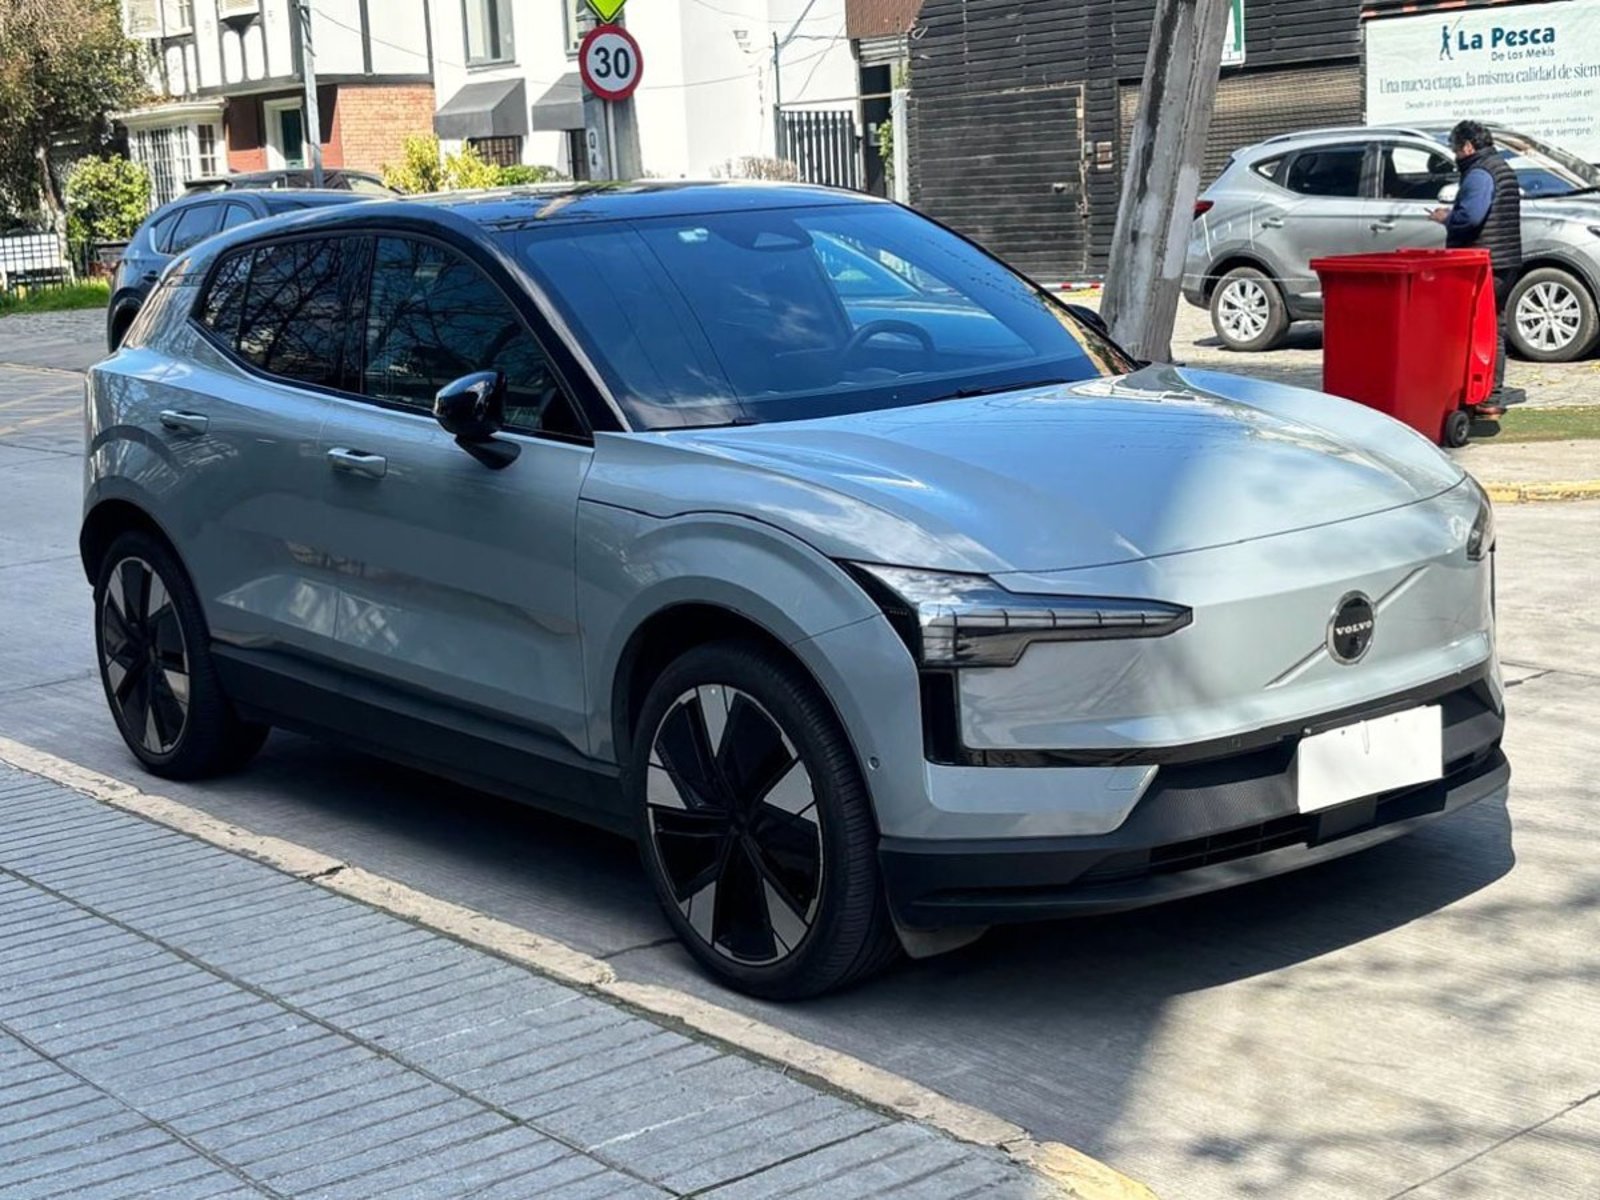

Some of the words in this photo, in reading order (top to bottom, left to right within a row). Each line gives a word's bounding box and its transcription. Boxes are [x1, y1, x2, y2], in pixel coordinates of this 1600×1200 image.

[1458, 31, 1483, 51] La
[1491, 27, 1555, 49] Pesca
[594, 47, 631, 79] 30
[1491, 51, 1504, 61] De
[1507, 49, 1523, 60] Los
[1525, 46, 1555, 58] Mekis
[1379, 78, 1399, 93] Una
[1401, 79, 1431, 92] nueva
[1466, 71, 1476, 87] la
[1477, 71, 1514, 86] misma
[1516, 64, 1555, 83] calidad
[1558, 63, 1572, 80] de
[1335, 620, 1373, 635] VOLVO
